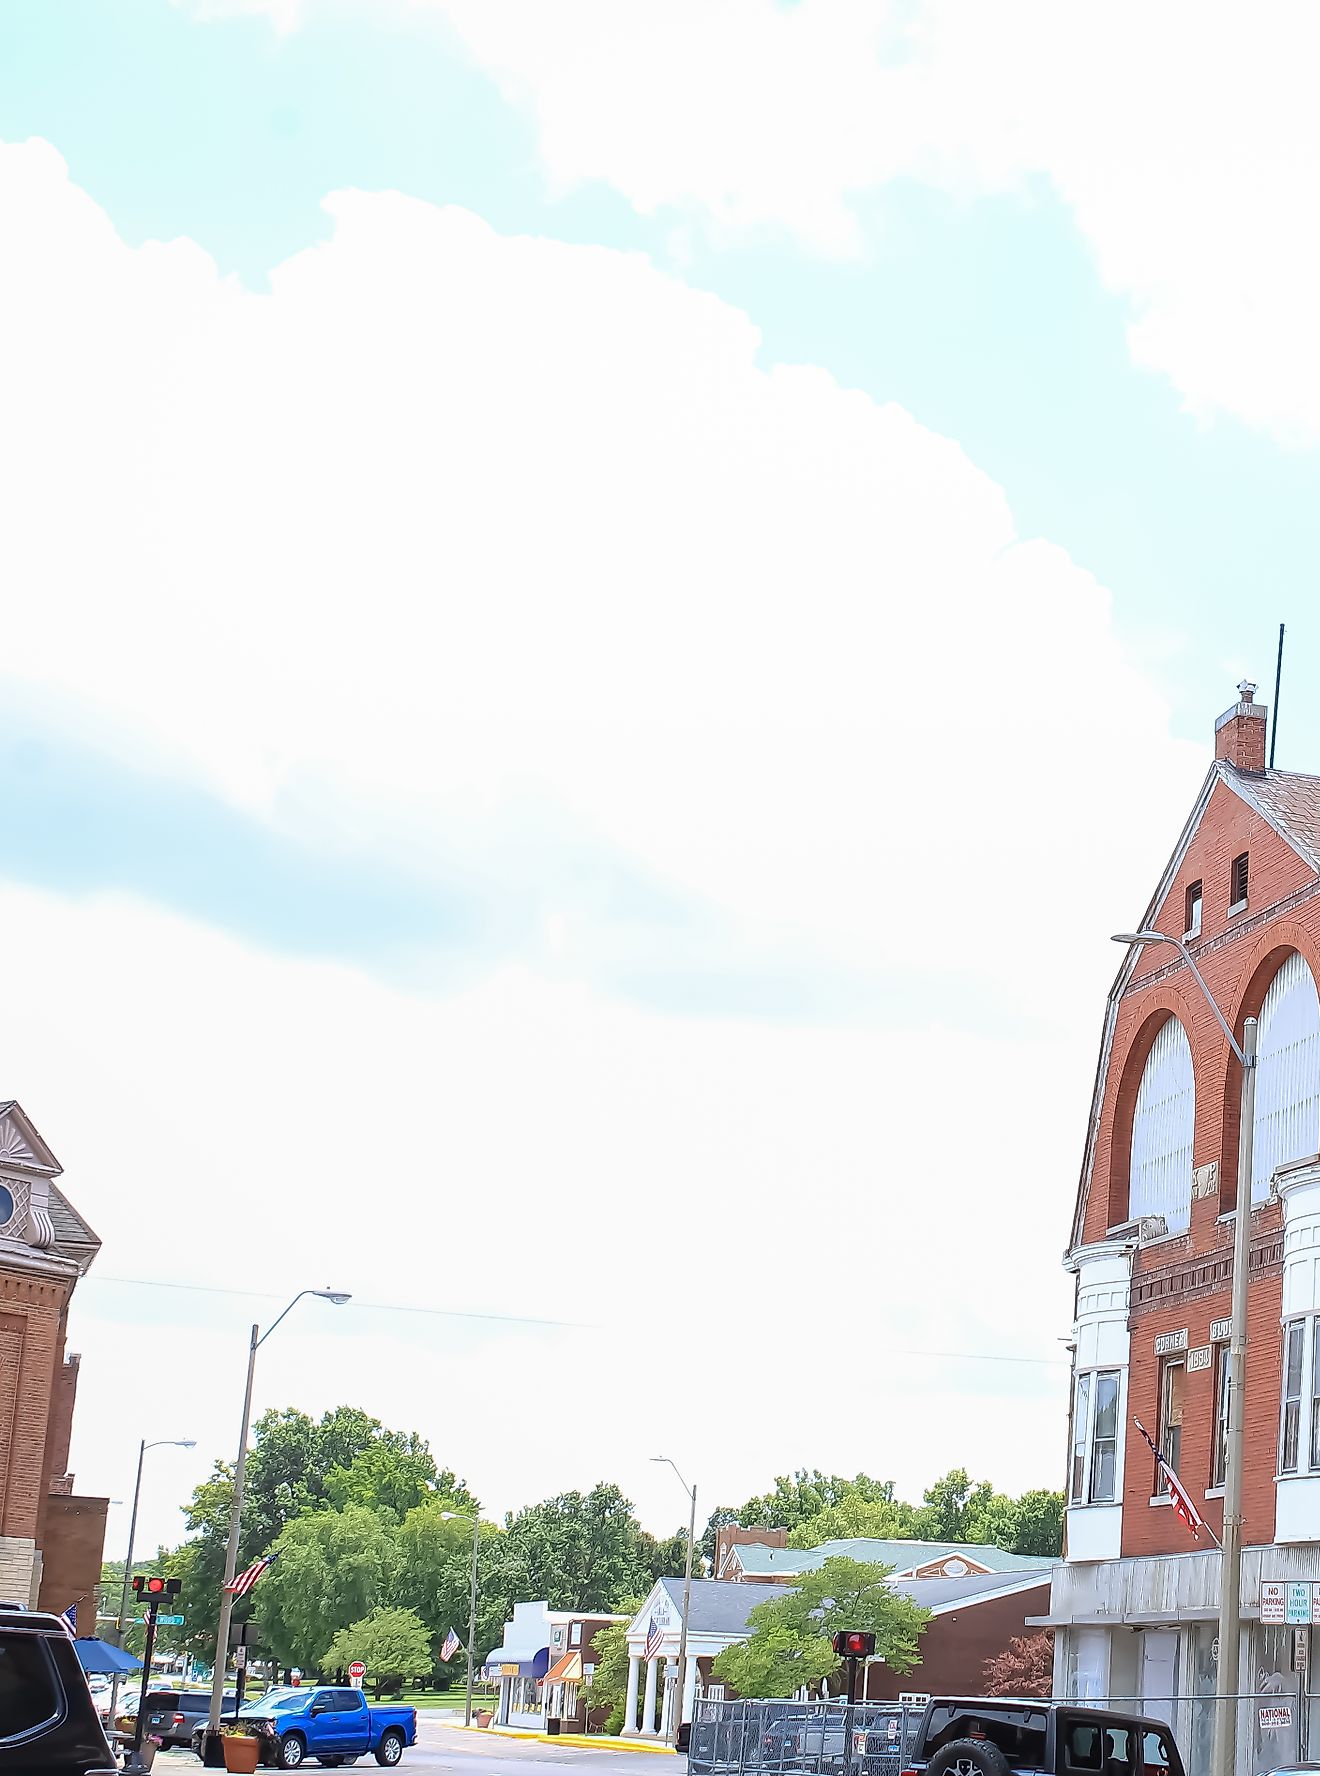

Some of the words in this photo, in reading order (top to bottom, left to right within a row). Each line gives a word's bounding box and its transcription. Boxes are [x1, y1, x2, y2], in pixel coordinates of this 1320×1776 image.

[1268, 1587, 1279, 1596] NO
[1292, 1588, 1305, 1597] TWO
[1262, 1598, 1284, 1606] PARKING
[1289, 1599, 1307, 1607] HOUR
[1260, 1708, 1290, 1719] NATIONAL
